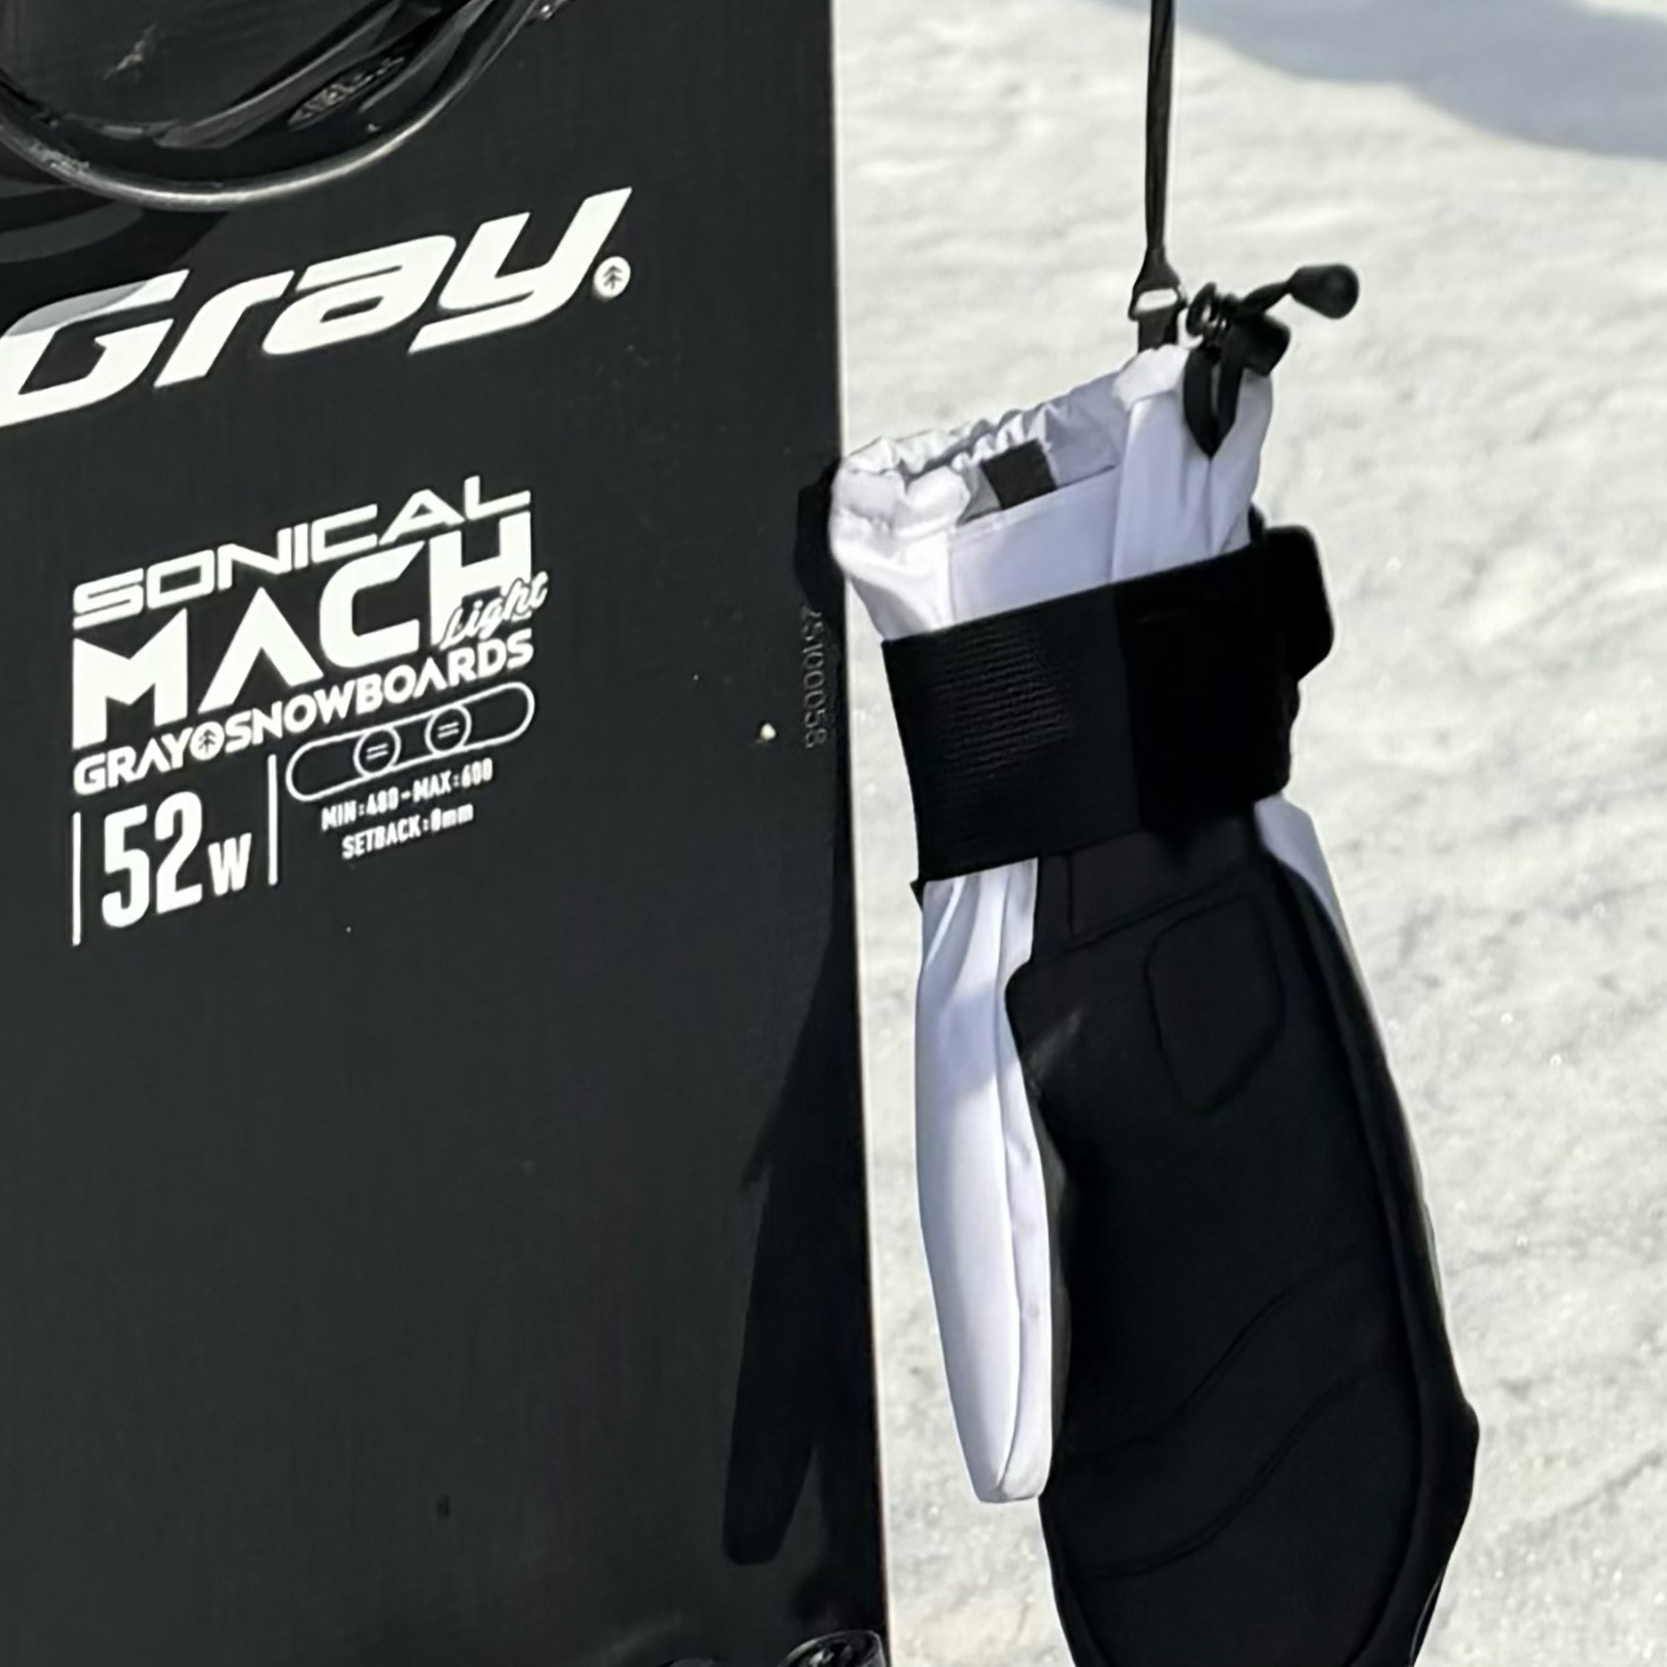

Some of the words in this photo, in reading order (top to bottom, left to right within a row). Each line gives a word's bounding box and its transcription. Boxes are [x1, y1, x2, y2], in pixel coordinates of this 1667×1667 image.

[0, 186, 633, 428] Gray
[72, 475, 531, 631] SONICAL
[72, 510, 531, 750] MACH
